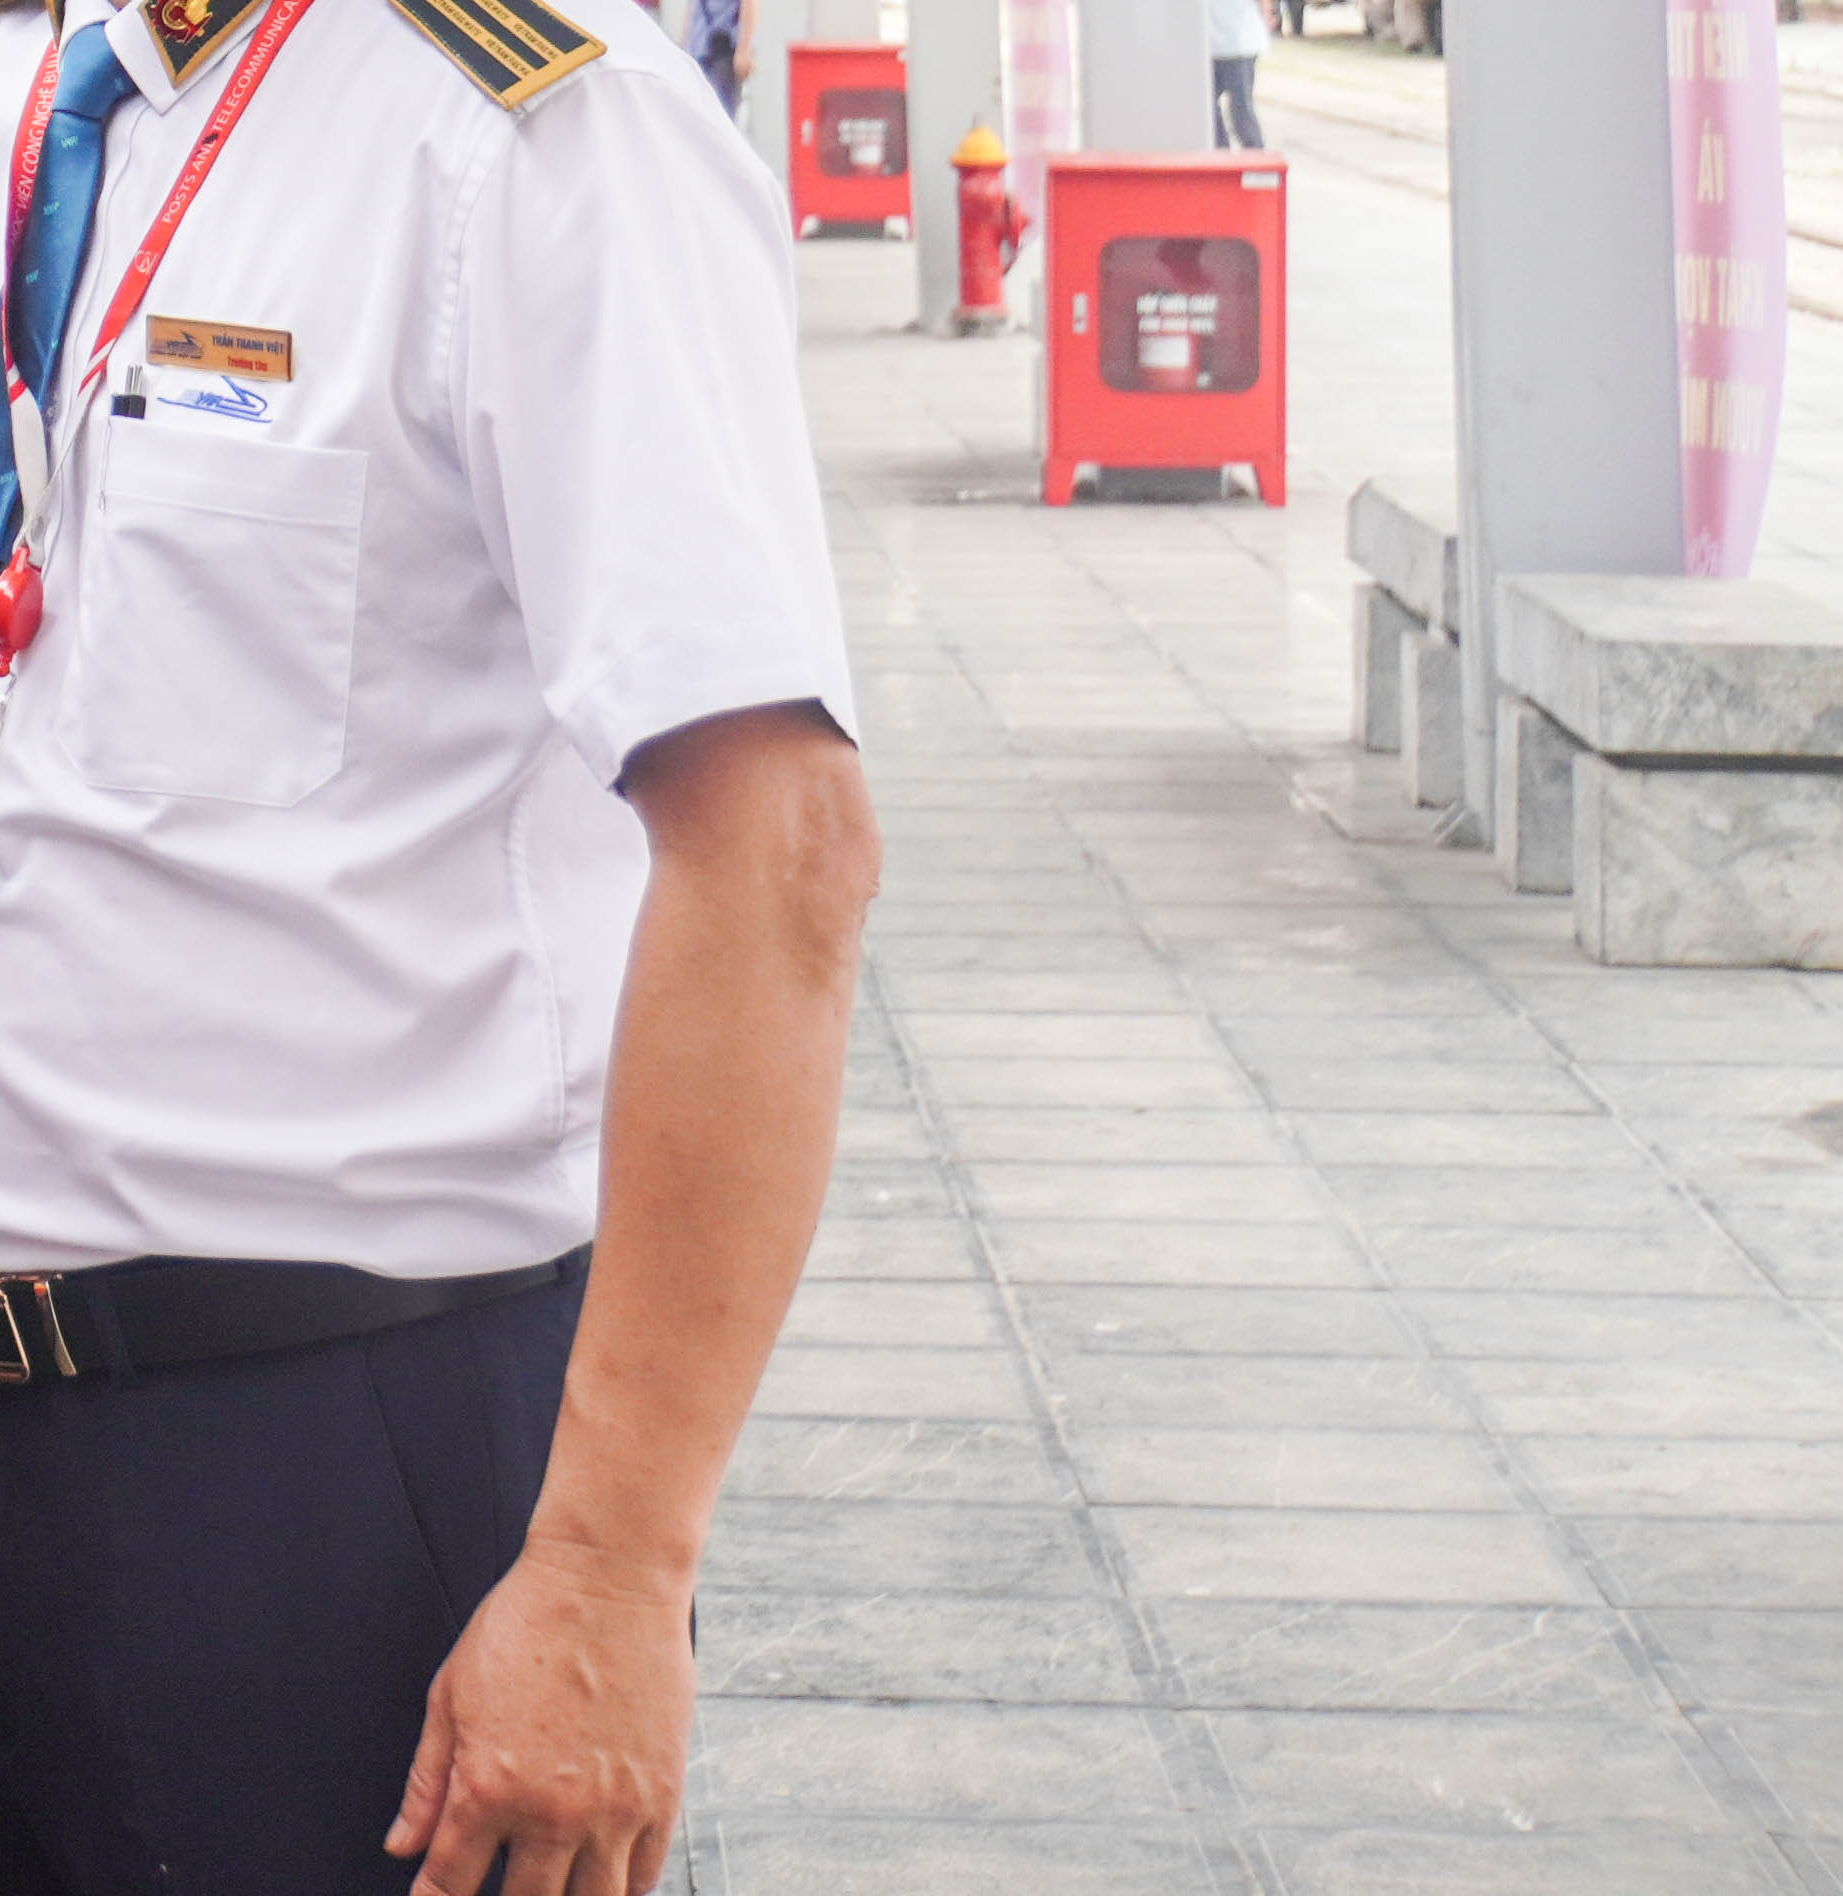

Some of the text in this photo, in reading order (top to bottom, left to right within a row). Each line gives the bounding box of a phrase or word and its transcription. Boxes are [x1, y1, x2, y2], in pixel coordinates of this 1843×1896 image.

[22, 127, 45, 175] CÔNG
[162, 173, 196, 224] POSTS
[236, 337, 264, 352] THANH
